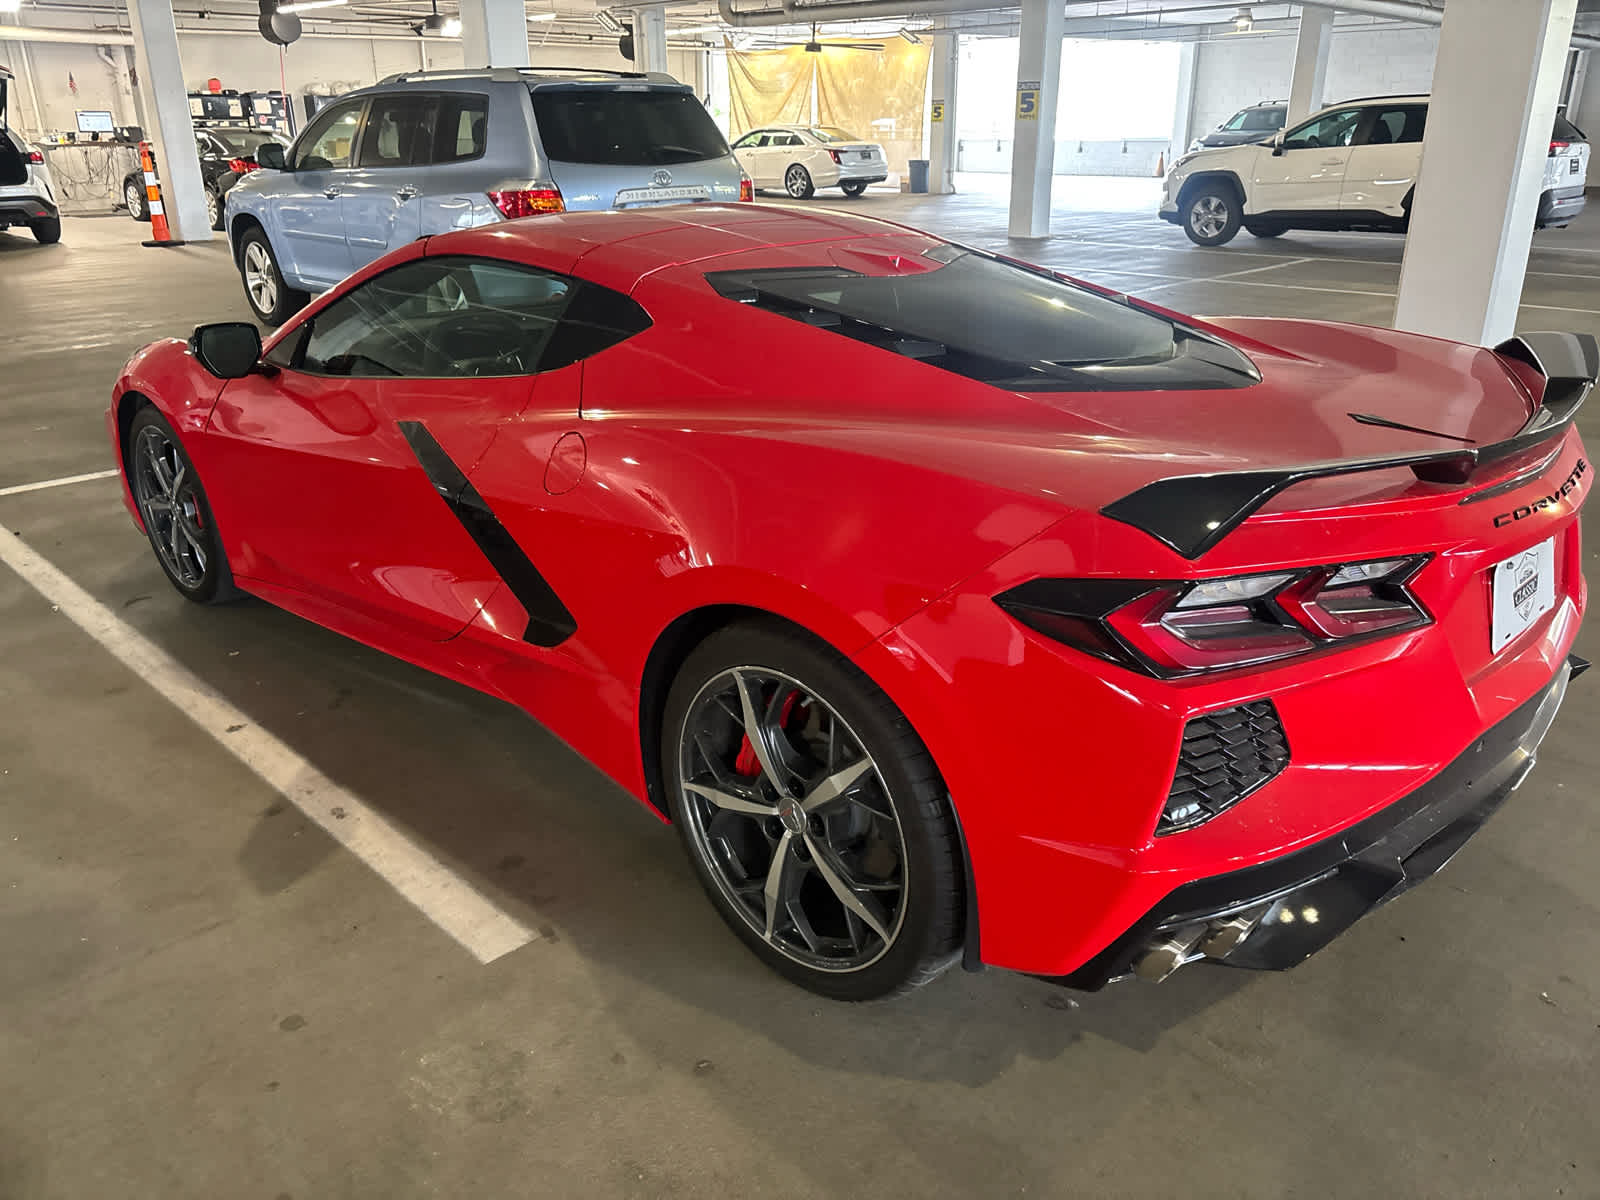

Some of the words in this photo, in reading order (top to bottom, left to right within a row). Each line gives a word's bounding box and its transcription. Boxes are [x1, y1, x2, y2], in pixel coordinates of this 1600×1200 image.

[933, 106, 942, 118] 5
[1021, 92, 1034, 112] 5
[1493, 458, 1586, 528] CORVETTE
